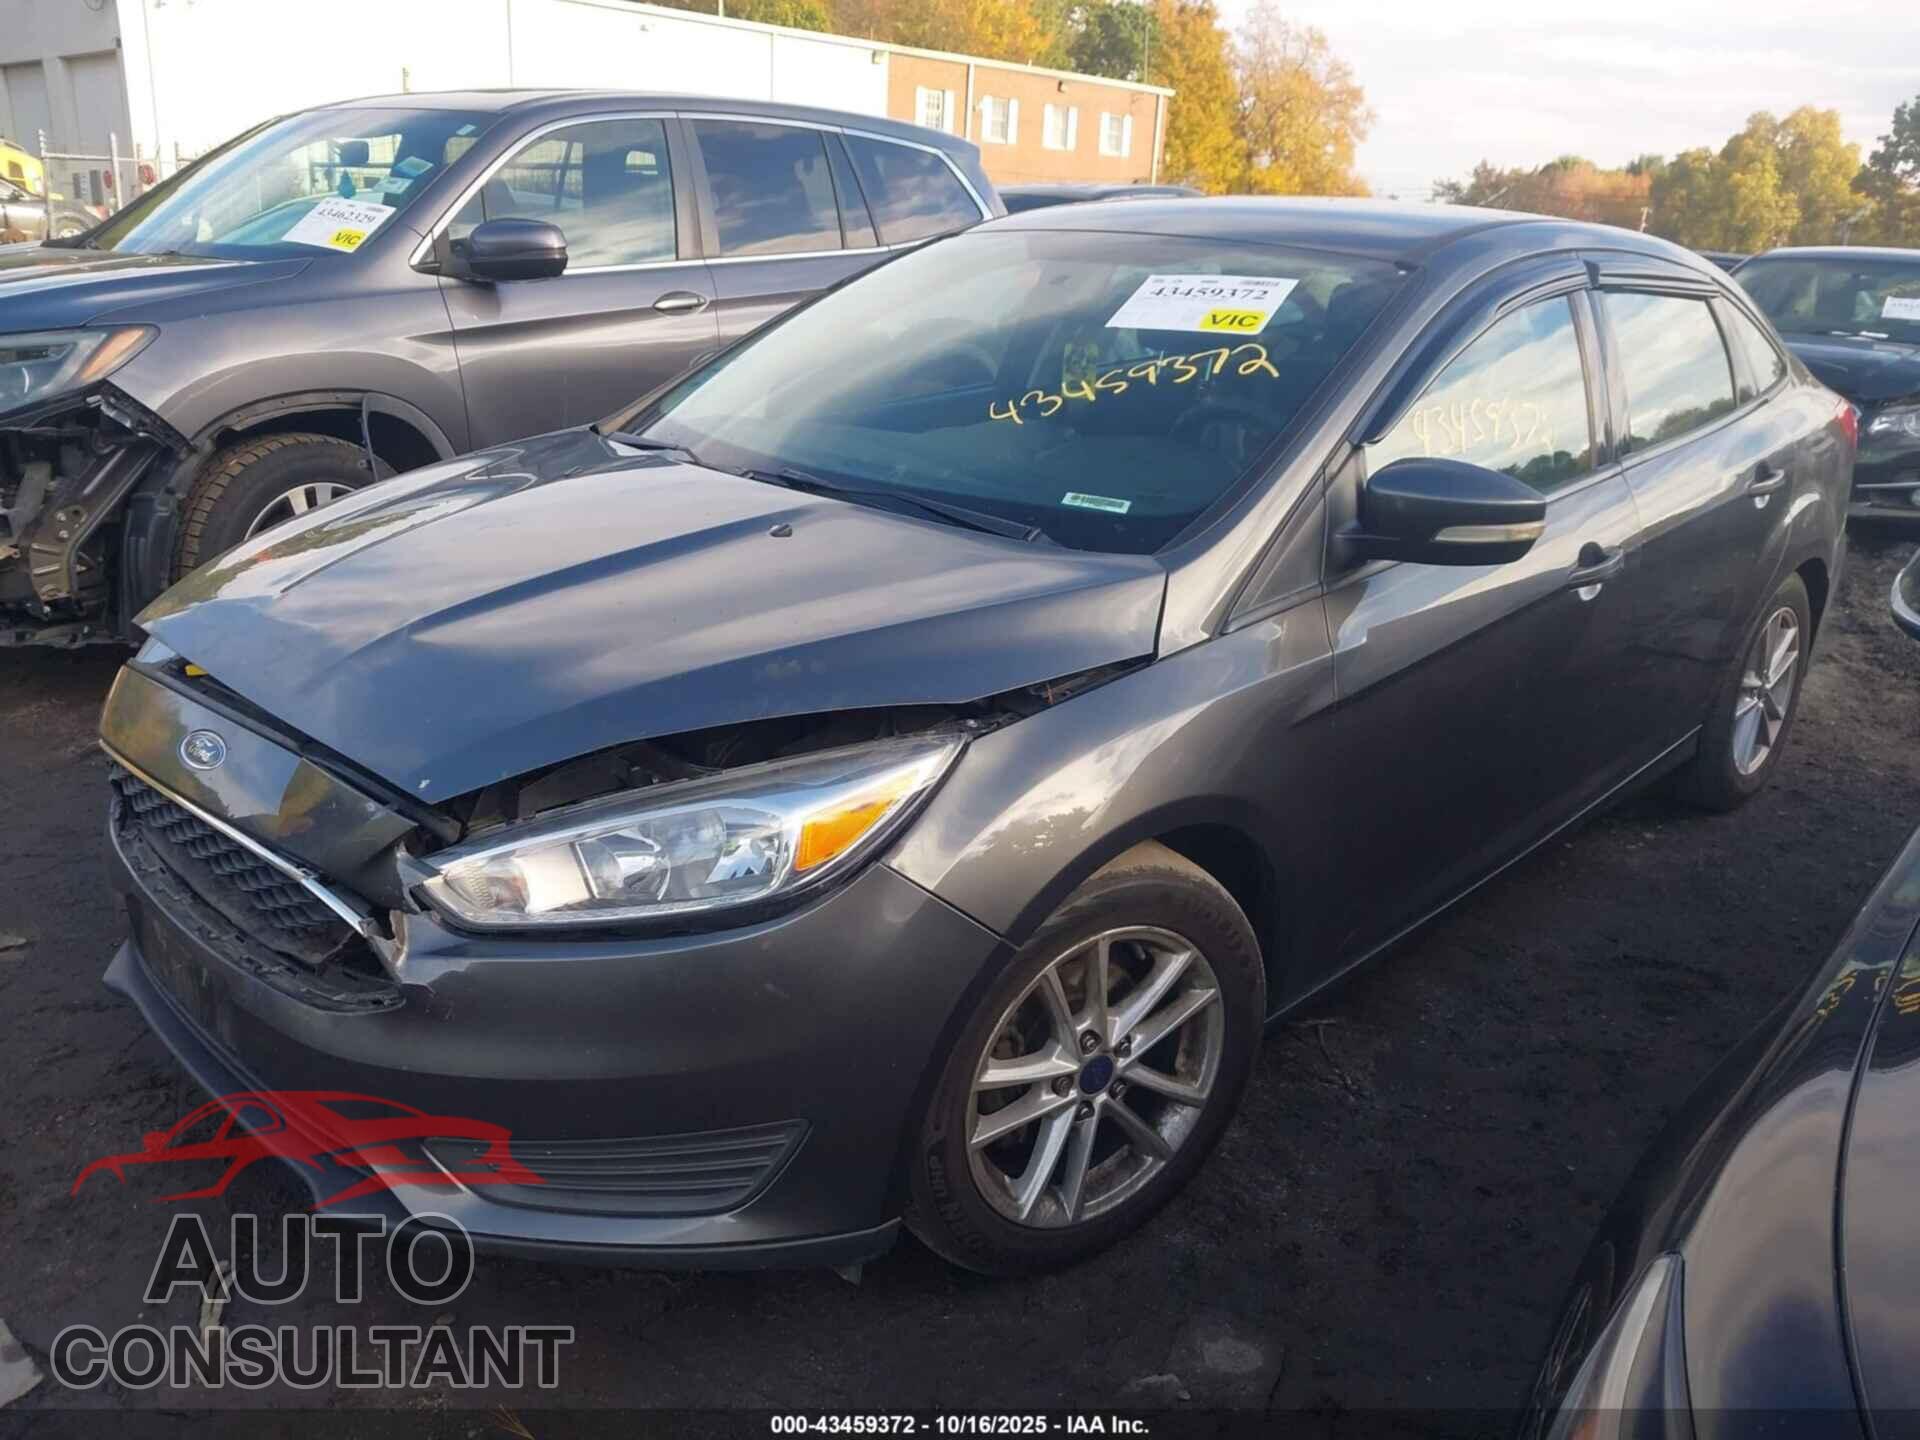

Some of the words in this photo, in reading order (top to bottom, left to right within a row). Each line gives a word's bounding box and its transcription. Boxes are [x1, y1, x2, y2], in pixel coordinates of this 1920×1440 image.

[335, 232, 361, 245] VIC
[1150, 287, 1269, 300] 43459372
[1211, 313, 1259, 328] VIC
[989, 342, 1280, 425] 43459372
